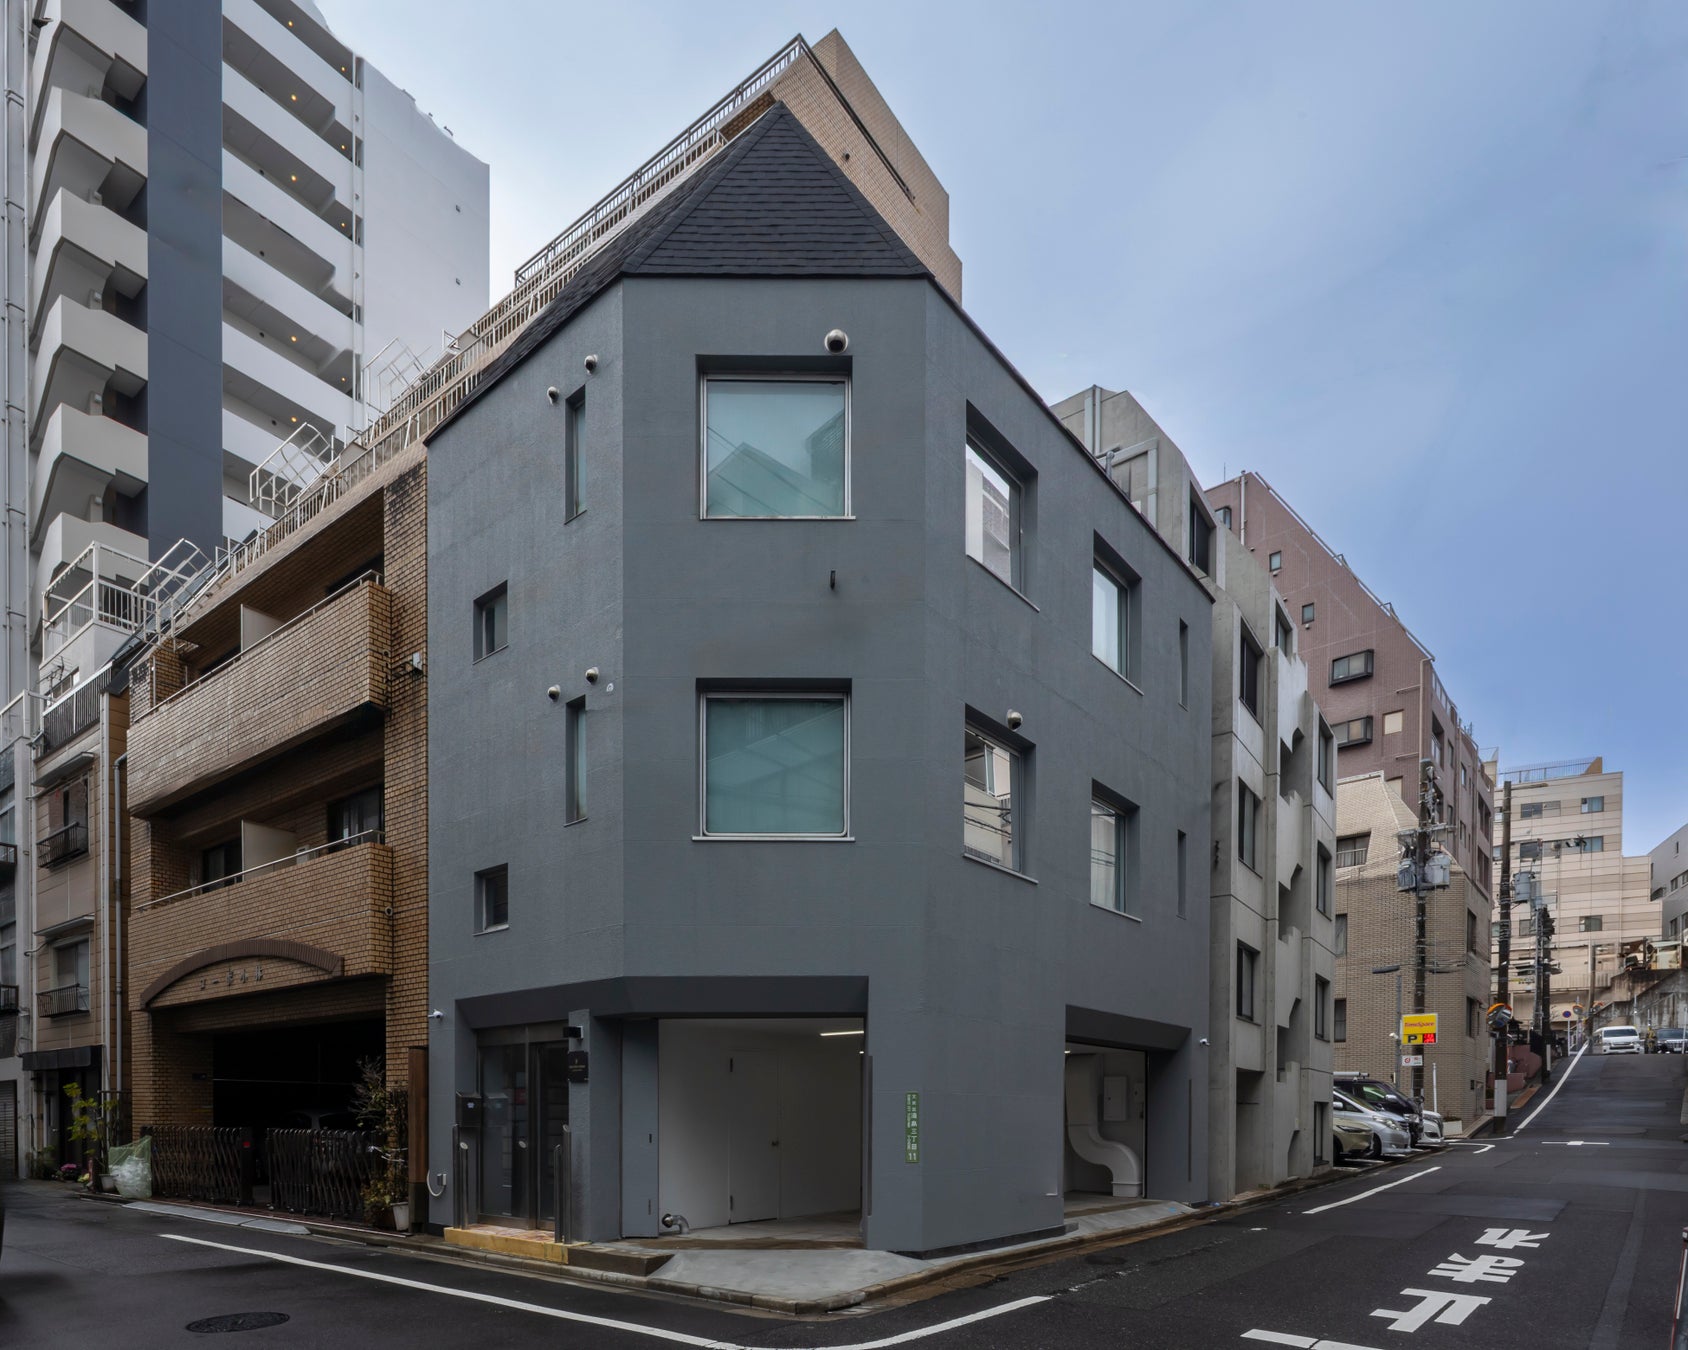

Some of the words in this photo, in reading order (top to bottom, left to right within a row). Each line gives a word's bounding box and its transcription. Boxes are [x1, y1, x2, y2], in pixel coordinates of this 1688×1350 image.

[1407, 1034, 1418, 1043] P
[908, 1152, 917, 1161] 11
[1368, 1227, 1551, 1333] 止まれ
